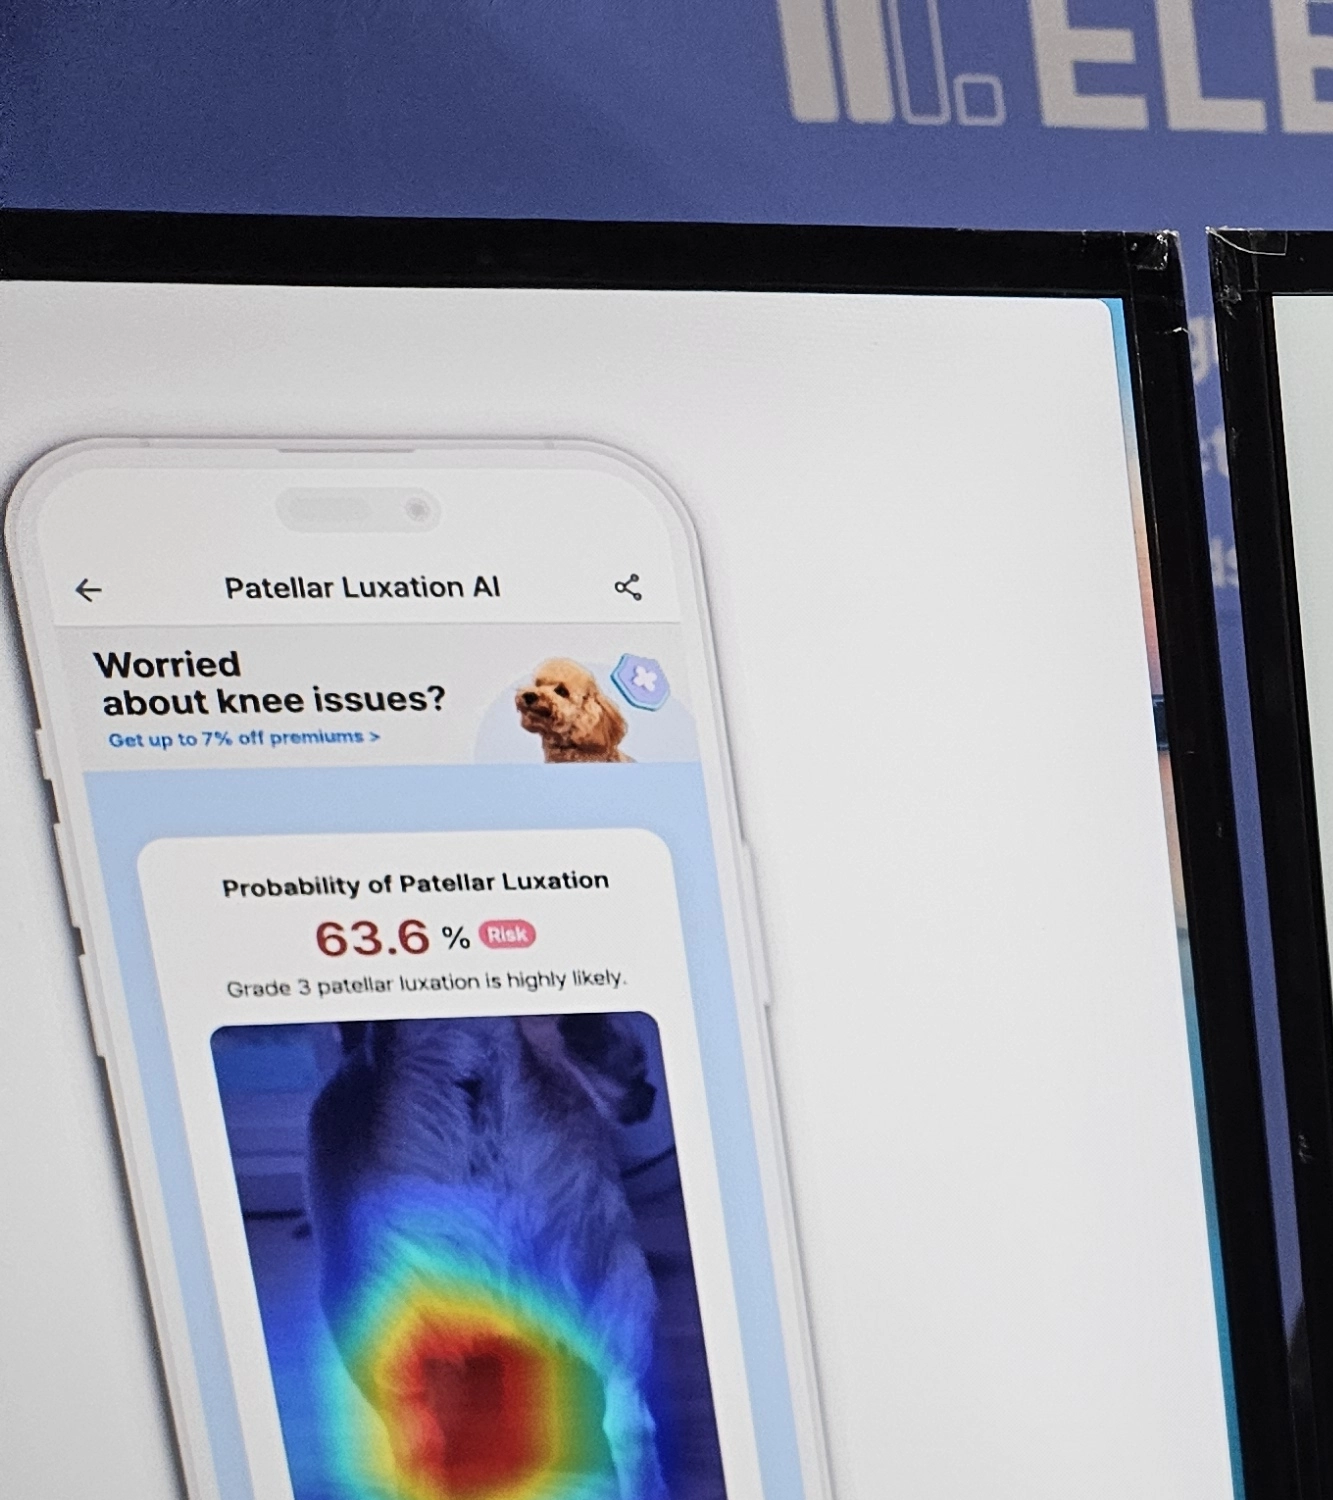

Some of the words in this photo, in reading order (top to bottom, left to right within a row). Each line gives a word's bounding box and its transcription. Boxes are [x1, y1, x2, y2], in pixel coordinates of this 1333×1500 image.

[225, 576, 334, 599] Patellar
[343, 575, 464, 598] Luxation
[473, 575, 501, 598] AI
[93, 650, 241, 679] Worried
[103, 689, 210, 717] about
[216, 687, 305, 715] knee
[312, 685, 446, 712] issues?
[108, 733, 142, 749] Get
[149, 734, 173, 752] up
[178, 733, 197, 747] to
[201, 731, 233, 747] 7%
[238, 730, 265, 746] off
[270, 729, 363, 749] premiums
[222, 877, 360, 900] Probability
[368, 875, 392, 894] of
[400, 873, 496, 893] Patellar
[502, 871, 609, 891] Luxation
[316, 919, 430, 959] 63.6
[442, 926, 471, 951] %
[486, 926, 530, 943] Risk
[226, 978, 291, 998] Grade
[298, 978, 311, 996] 3
[318, 975, 394, 998] patellar
[400, 973, 479, 992] luxation
[486, 972, 501, 990] is
[507, 970, 566, 993] highly
[572, 968, 628, 990] likely.
